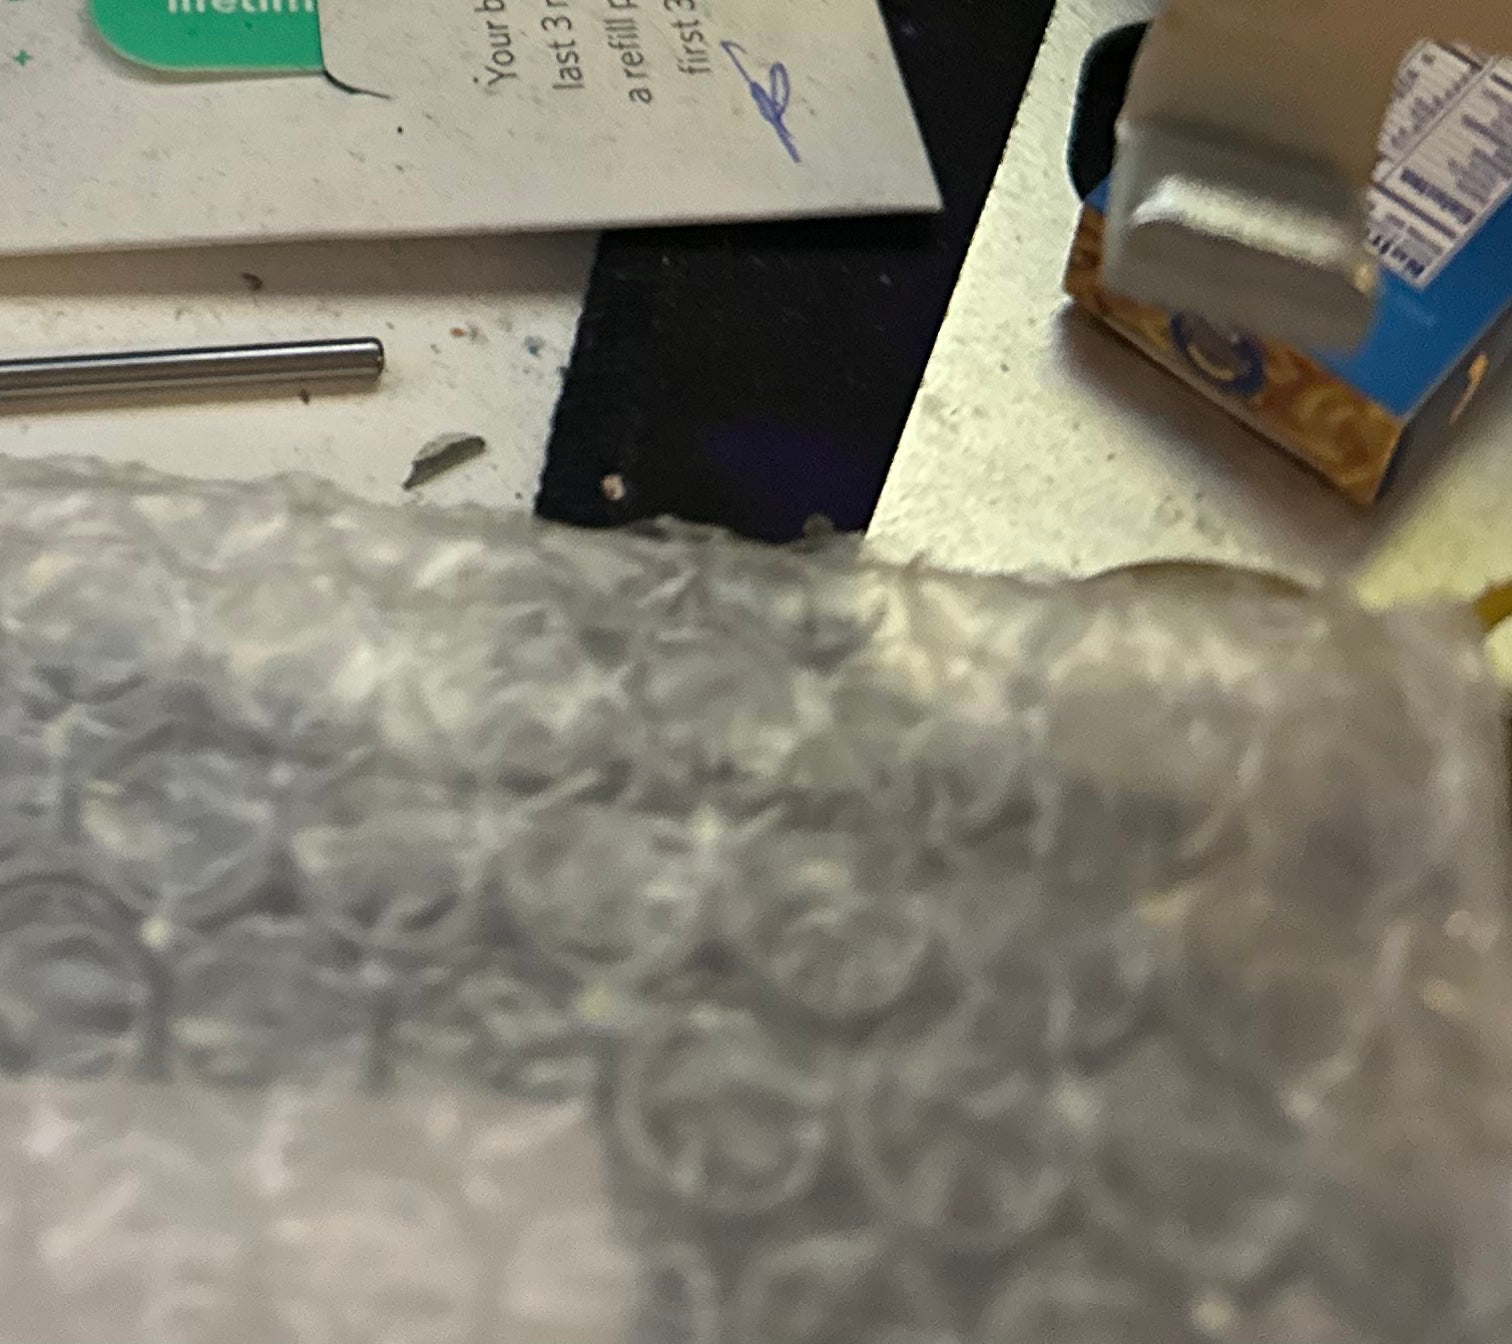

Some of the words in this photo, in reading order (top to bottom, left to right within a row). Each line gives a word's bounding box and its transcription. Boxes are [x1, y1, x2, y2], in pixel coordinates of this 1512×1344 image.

[542, 15, 573, 31] 3
[604, 18, 647, 80] refill
[673, 19, 713, 76] first
[486, 21, 519, 87] Your
[551, 38, 584, 90] last
[630, 87, 653, 104] a
